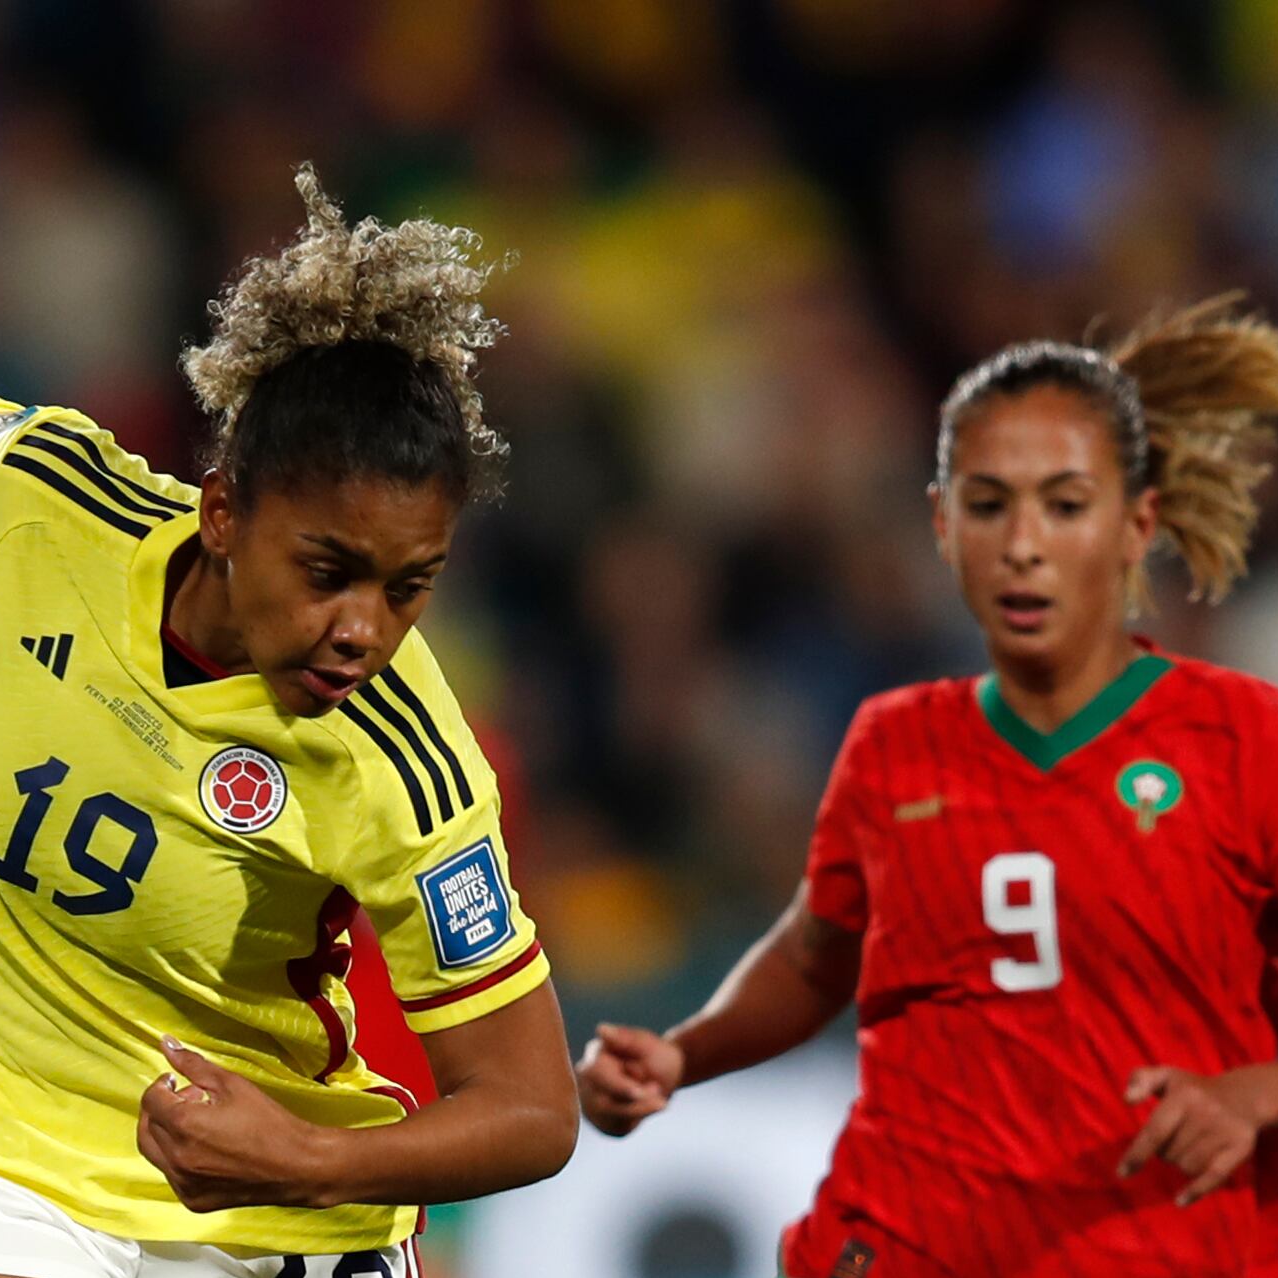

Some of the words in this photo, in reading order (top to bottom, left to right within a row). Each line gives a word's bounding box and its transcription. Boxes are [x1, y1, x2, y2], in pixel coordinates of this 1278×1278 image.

[84, 684, 108, 704] PERTH
[130, 701, 163, 730] MOROCCO
[149, 729, 169, 748] 2023
[439, 862, 484, 897] FOOTBALL
[444, 876, 489, 915] UNITES
[447, 913, 467, 933] the
[465, 892, 498, 924] World
[980, 852, 1062, 992] 9
[469, 926, 490, 940] FIFA
